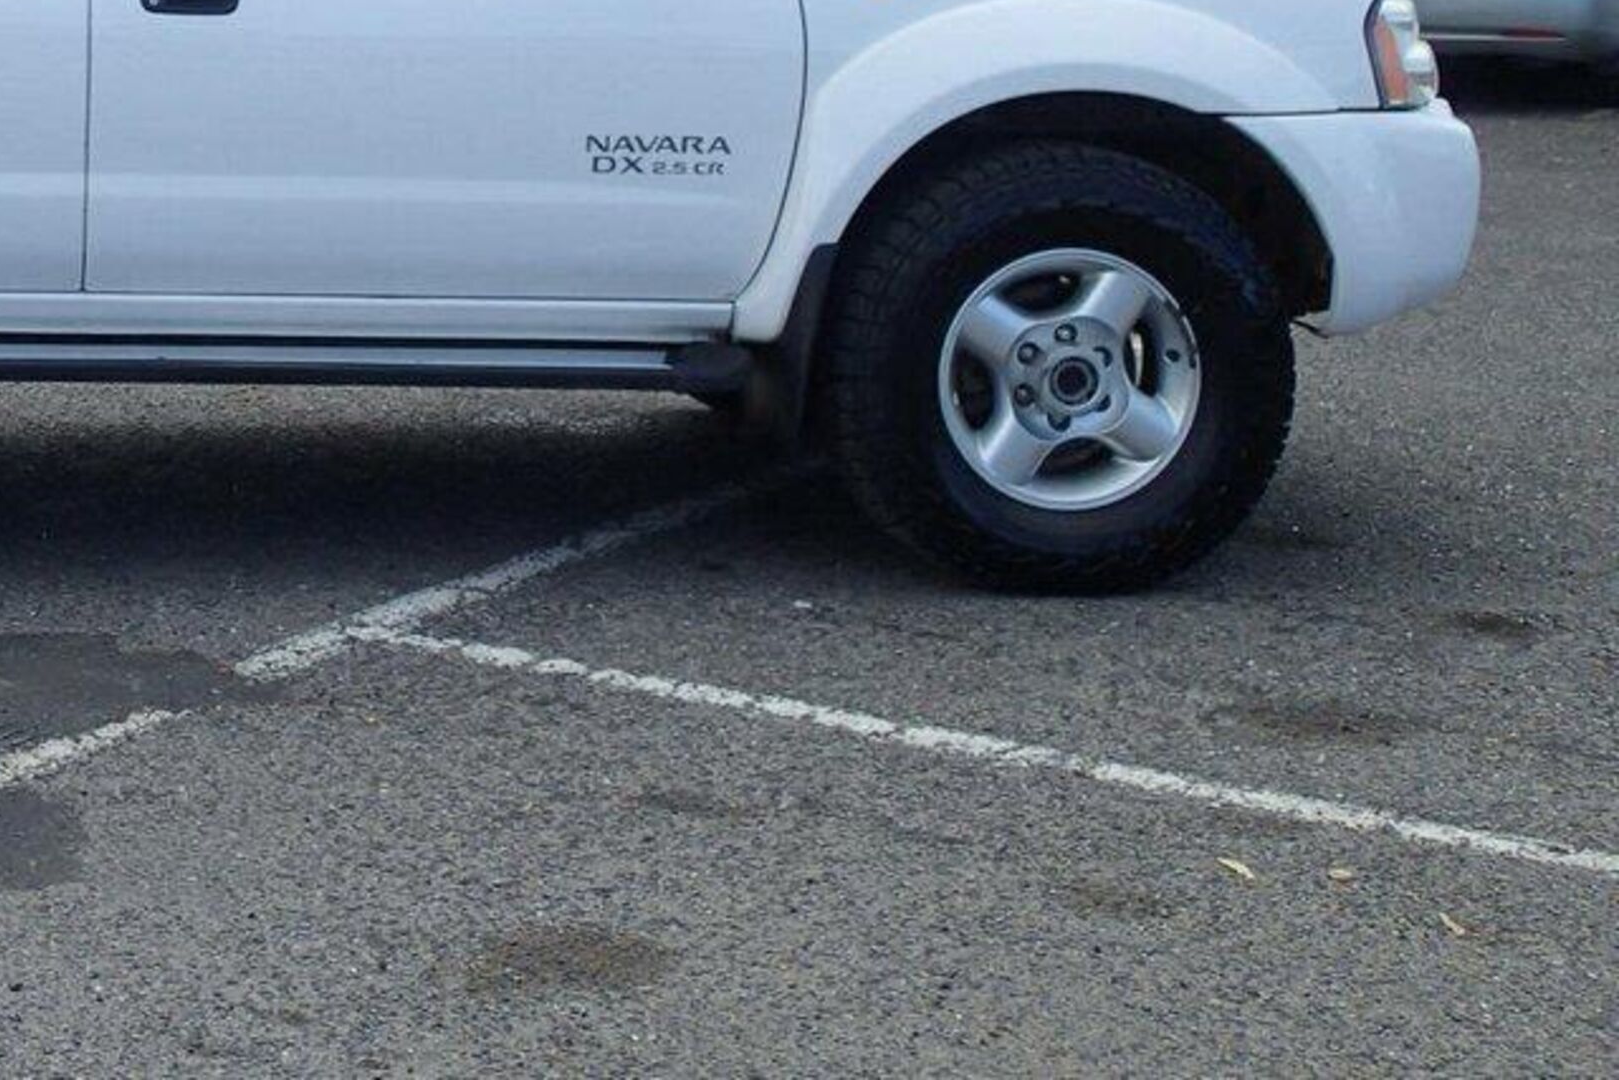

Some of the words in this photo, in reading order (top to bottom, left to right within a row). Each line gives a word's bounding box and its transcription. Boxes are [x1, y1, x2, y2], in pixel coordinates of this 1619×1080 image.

[585, 134, 732, 155] NAVARA
[591, 155, 645, 175] DX
[651, 160, 687, 176] 2.5
[693, 160, 726, 176] CR
